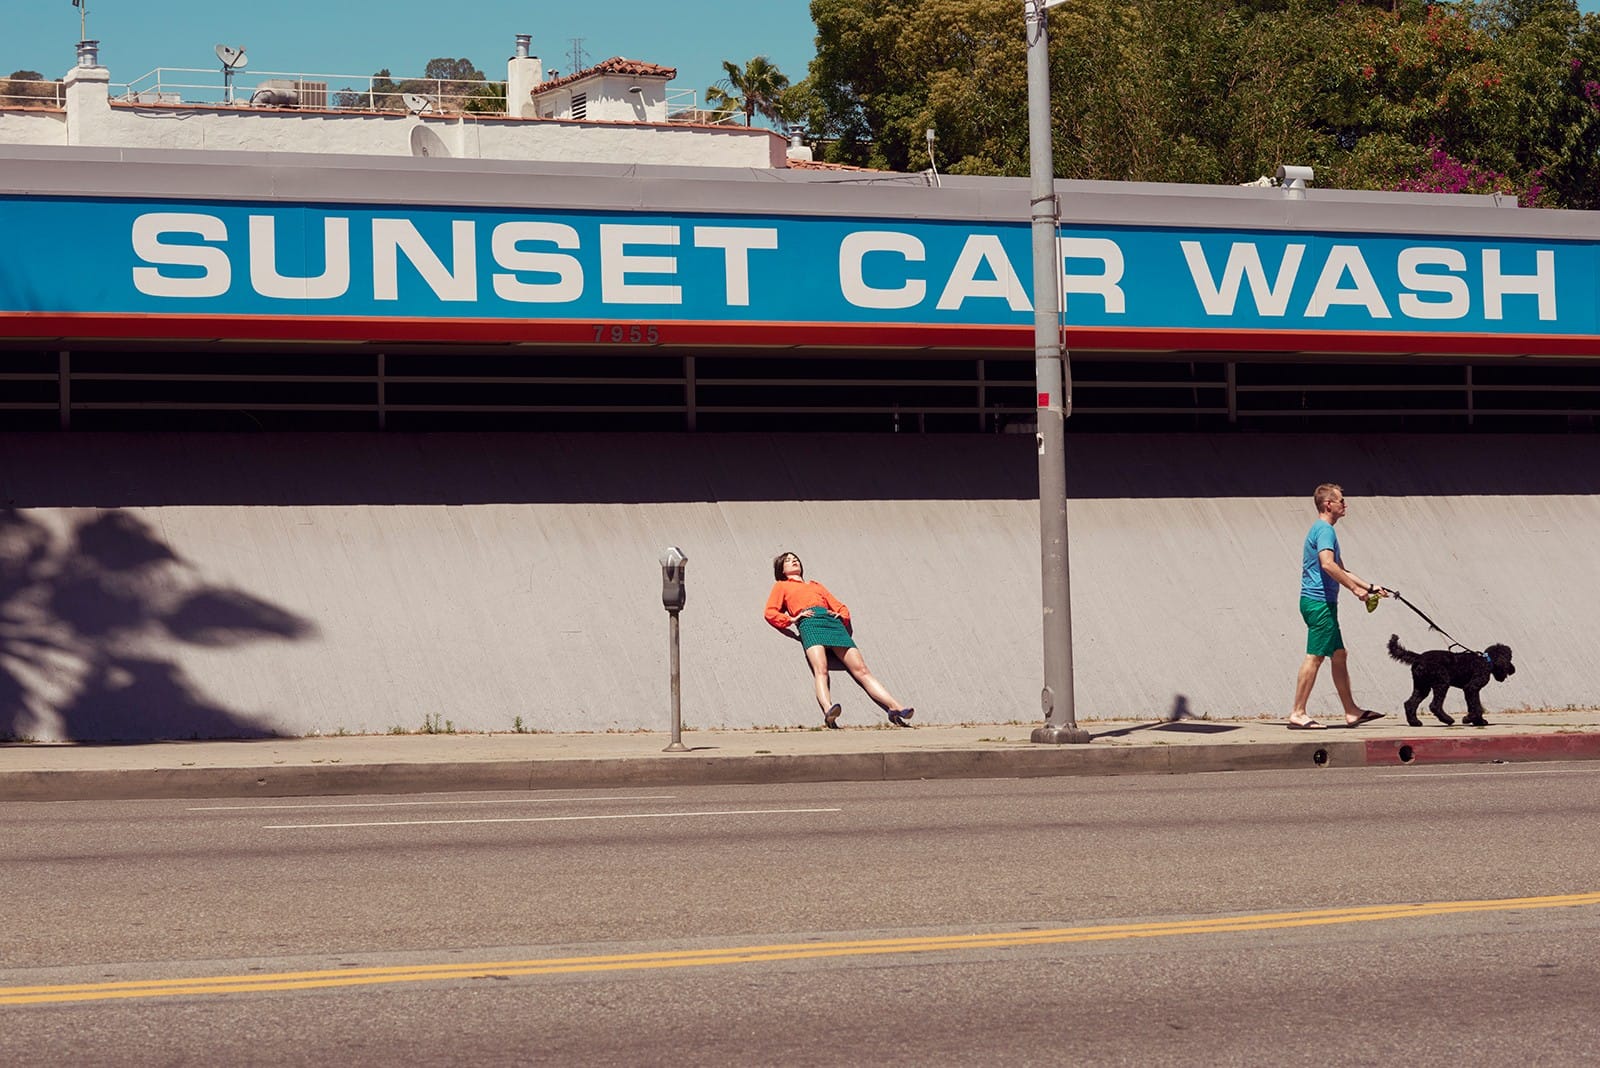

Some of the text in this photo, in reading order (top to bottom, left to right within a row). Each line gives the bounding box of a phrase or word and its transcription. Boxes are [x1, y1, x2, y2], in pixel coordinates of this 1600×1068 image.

[131, 212, 1557, 321] SUNSET CAR WASH
[591, 324, 660, 344] 7955
